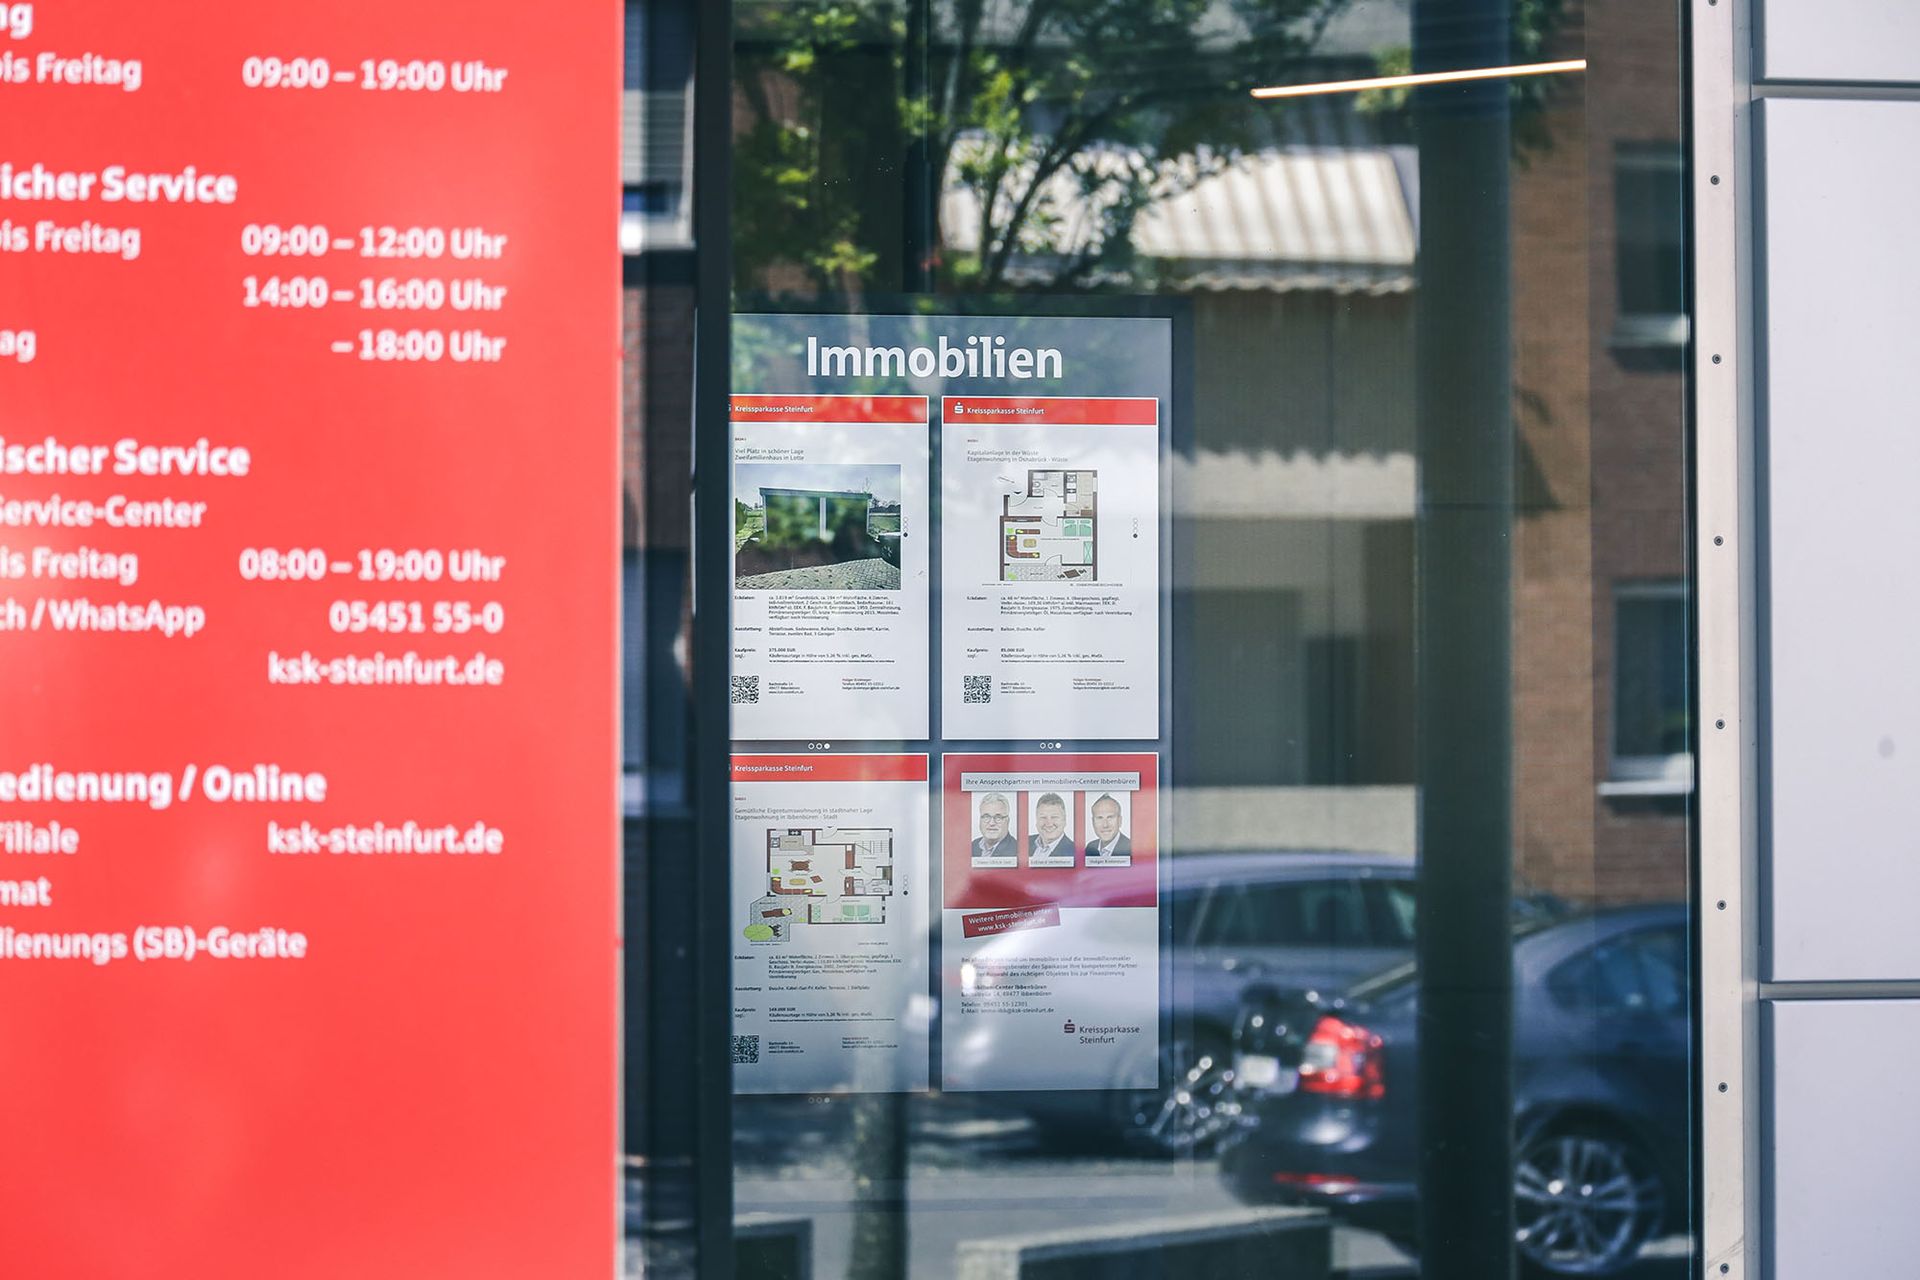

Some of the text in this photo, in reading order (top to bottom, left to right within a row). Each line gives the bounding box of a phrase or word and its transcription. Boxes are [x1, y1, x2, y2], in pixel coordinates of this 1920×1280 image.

[0, 51, 142, 92] is Freitag
[242, 57, 329, 89] 09:00
[360, 60, 446, 91] 19:00
[451, 61, 508, 92] Uhr
[101, 165, 237, 203] Service
[35, 220, 140, 260] Freitag
[241, 225, 328, 257] 09:00
[360, 228, 445, 259] 12:00
[450, 229, 507, 260] Uhr
[243, 277, 328, 308] 14:00
[360, 279, 444, 310] 16:00
[450, 280, 507, 311] Uhr
[359, 330, 444, 361] 18:00
[450, 331, 506, 362] Uhr
[807, 336, 1063, 379] Immobilien
[735, 405, 784, 413] Kreissparkasse
[967, 407, 1016, 415] Kreissparkasse
[113, 438, 250, 476] Service
[0, 494, 206, 527] ervice-Center
[32, 546, 138, 586] Freitag
[239, 548, 326, 580] 08:00
[357, 550, 443, 581] 19:00
[448, 551, 506, 582] Uhr
[48, 597, 206, 638] WhatsApp
[329, 601, 504, 634] 05451 55-0
[268, 651, 504, 685] ksk-steinfurt.de
[203, 764, 328, 802] Online
[735, 765, 784, 773] Kreissparkasse
[966, 778, 1136, 786] Ihre Ansprechpartner im Immobilien-Center Ibbenbüren
[268, 821, 504, 854] ksk-steinfurt.de
[968, 916, 994, 924] Weitere
[0, 925, 308, 966] ienungs (SB)-Geräte
[1080, 1026, 1140, 1034] Kreissparkasse
[1080, 1036, 1115, 1044] Steinfurt
